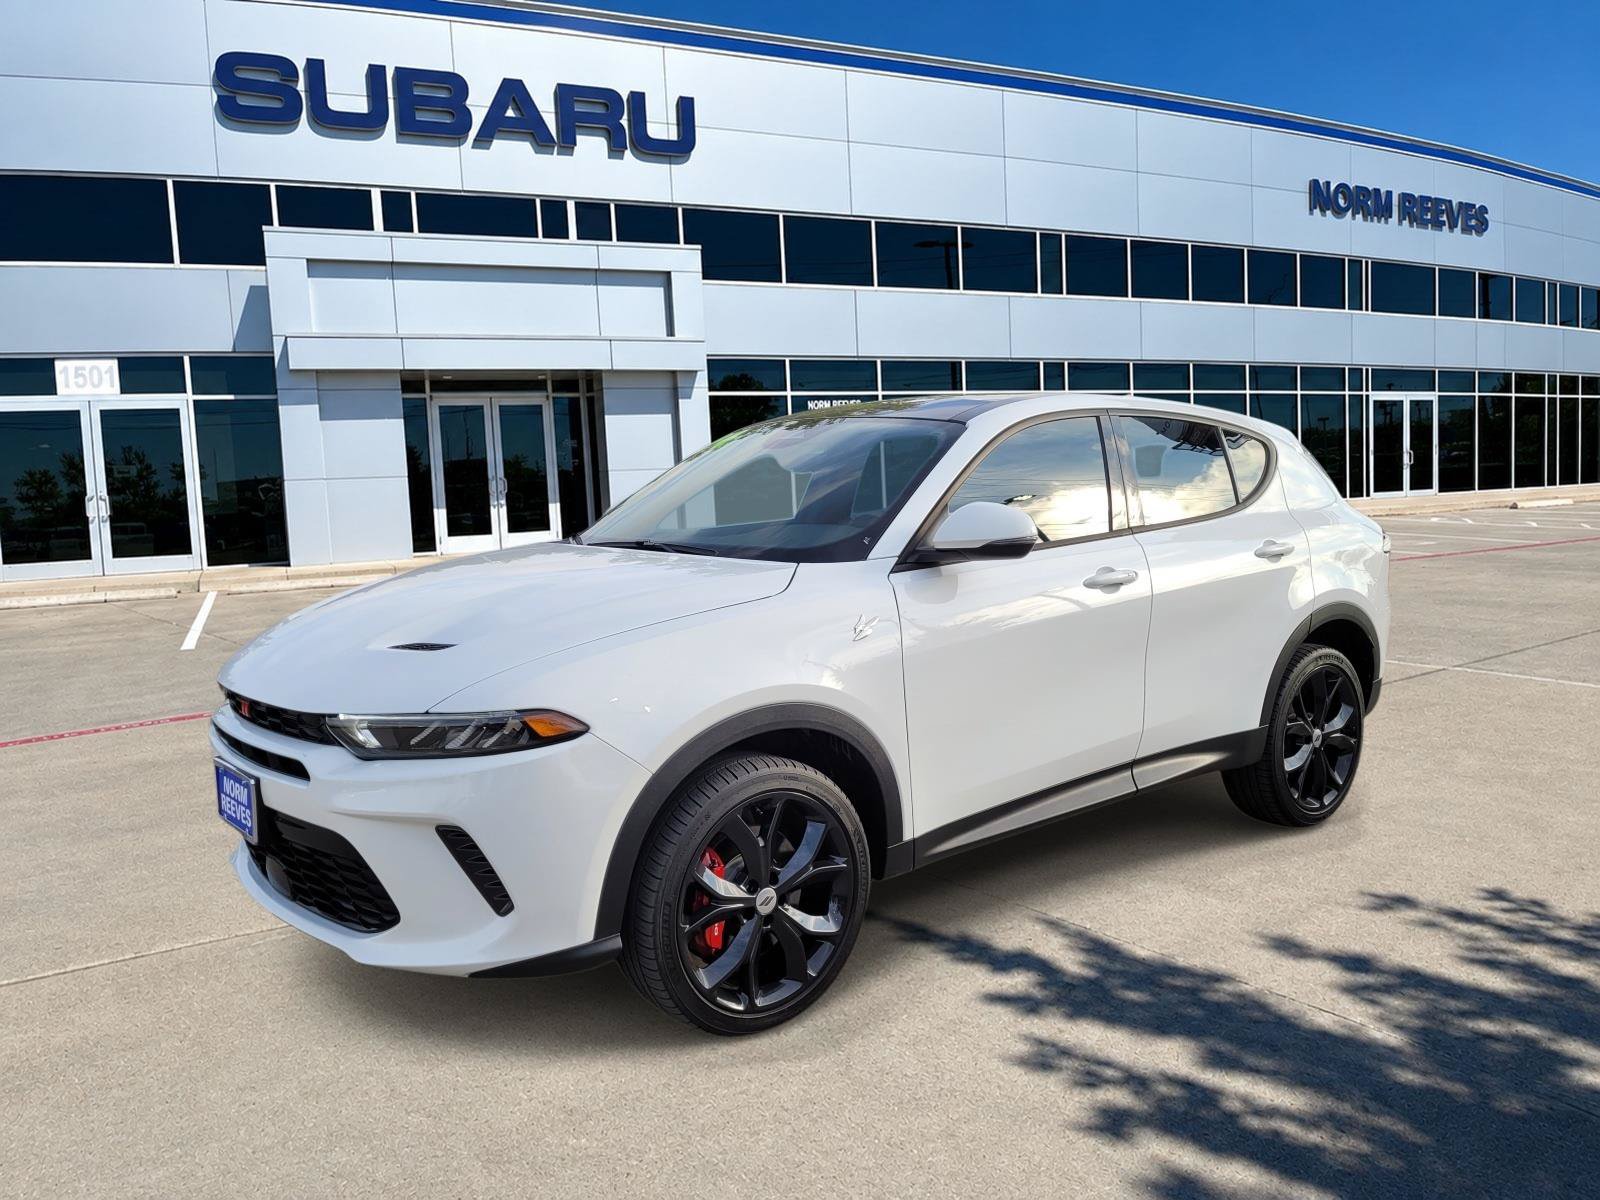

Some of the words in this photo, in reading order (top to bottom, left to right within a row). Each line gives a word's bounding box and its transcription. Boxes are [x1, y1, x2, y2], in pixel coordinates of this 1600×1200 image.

[213, 51, 697, 159] SUBARU
[1309, 178, 1393, 220] NORM
[1398, 192, 1490, 235] REEVES
[58, 364, 116, 389] 1501
[807, 399, 831, 410] NORM
[223, 775, 248, 807] NORM
[220, 792, 252, 828] REEVES
